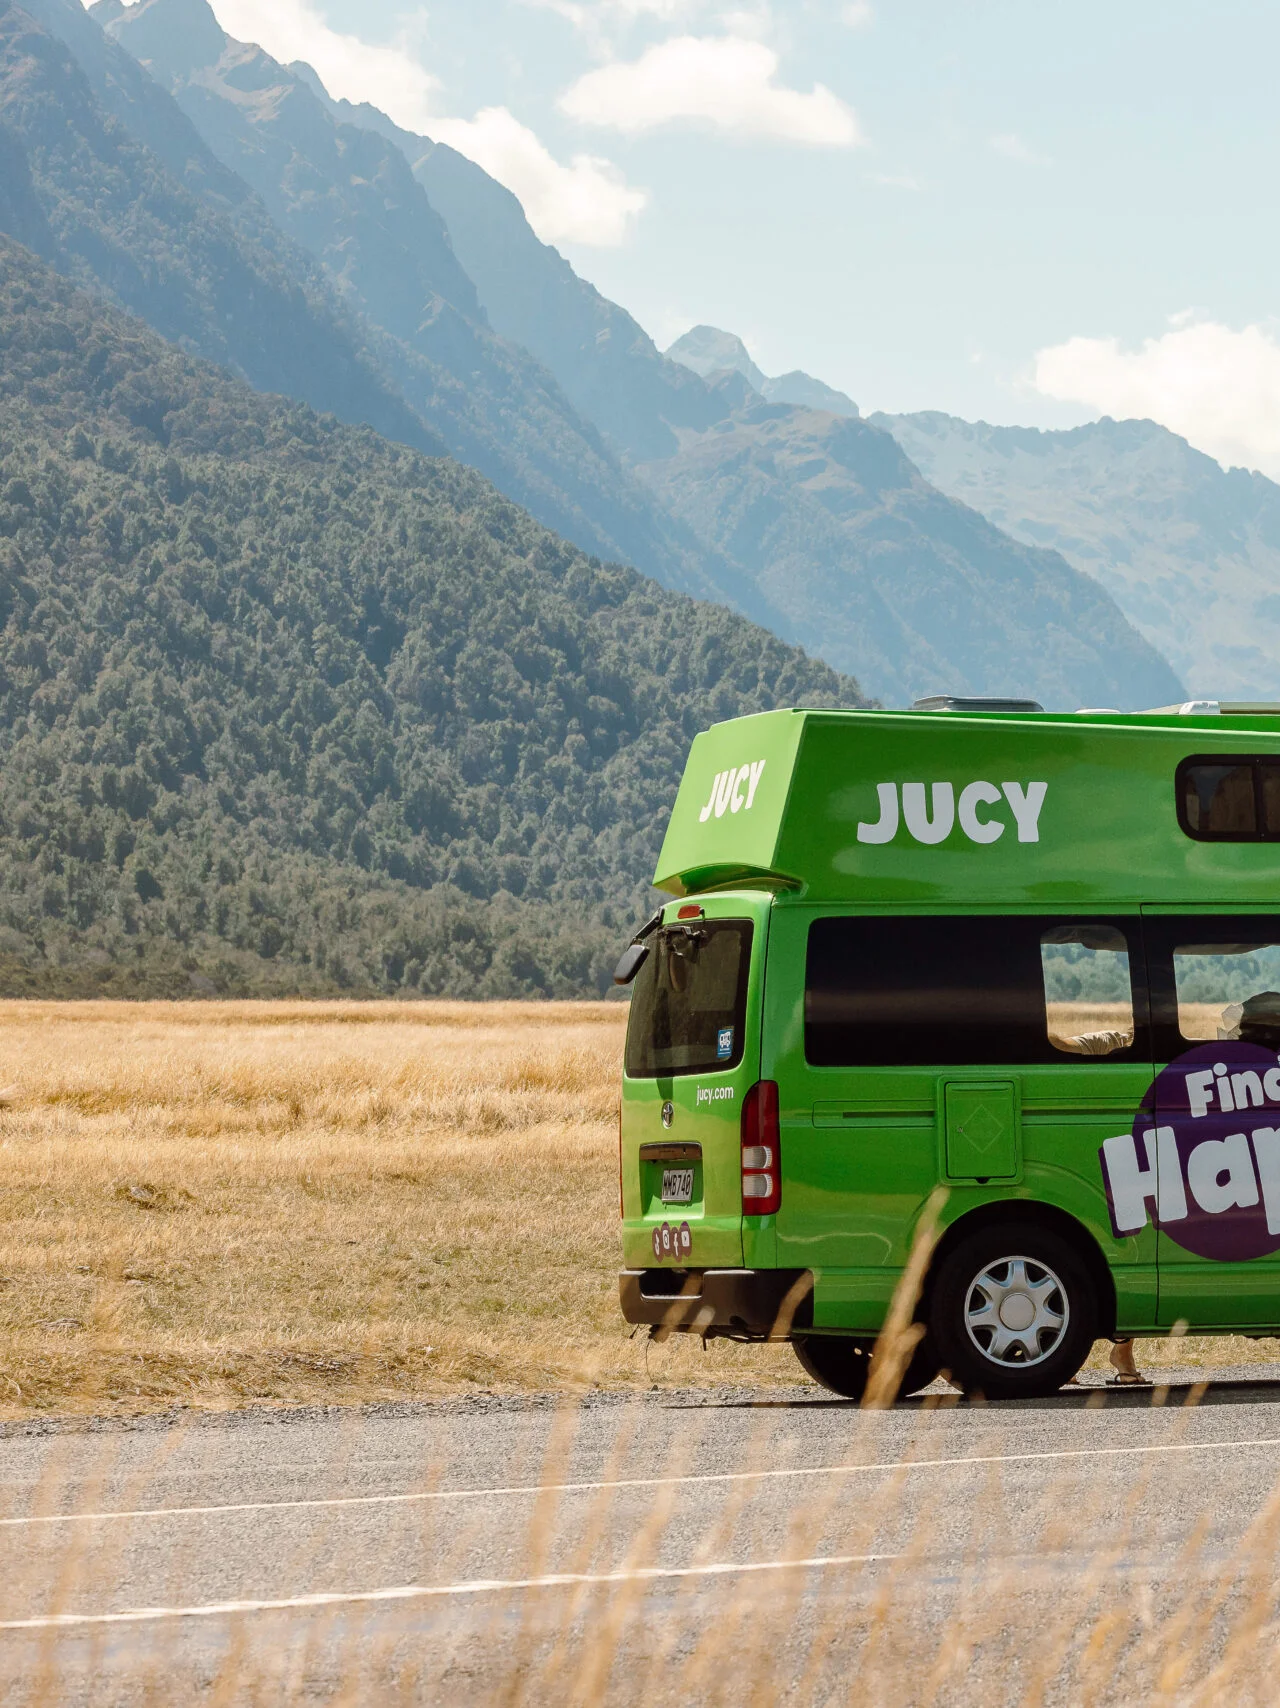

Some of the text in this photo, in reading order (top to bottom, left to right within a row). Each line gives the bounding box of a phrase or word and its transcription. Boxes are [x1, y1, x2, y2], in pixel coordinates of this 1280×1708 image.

[699, 759, 766, 822] JUCY
[857, 780, 1048, 844] JUCY
[696, 1085, 734, 1106] jucy.com
